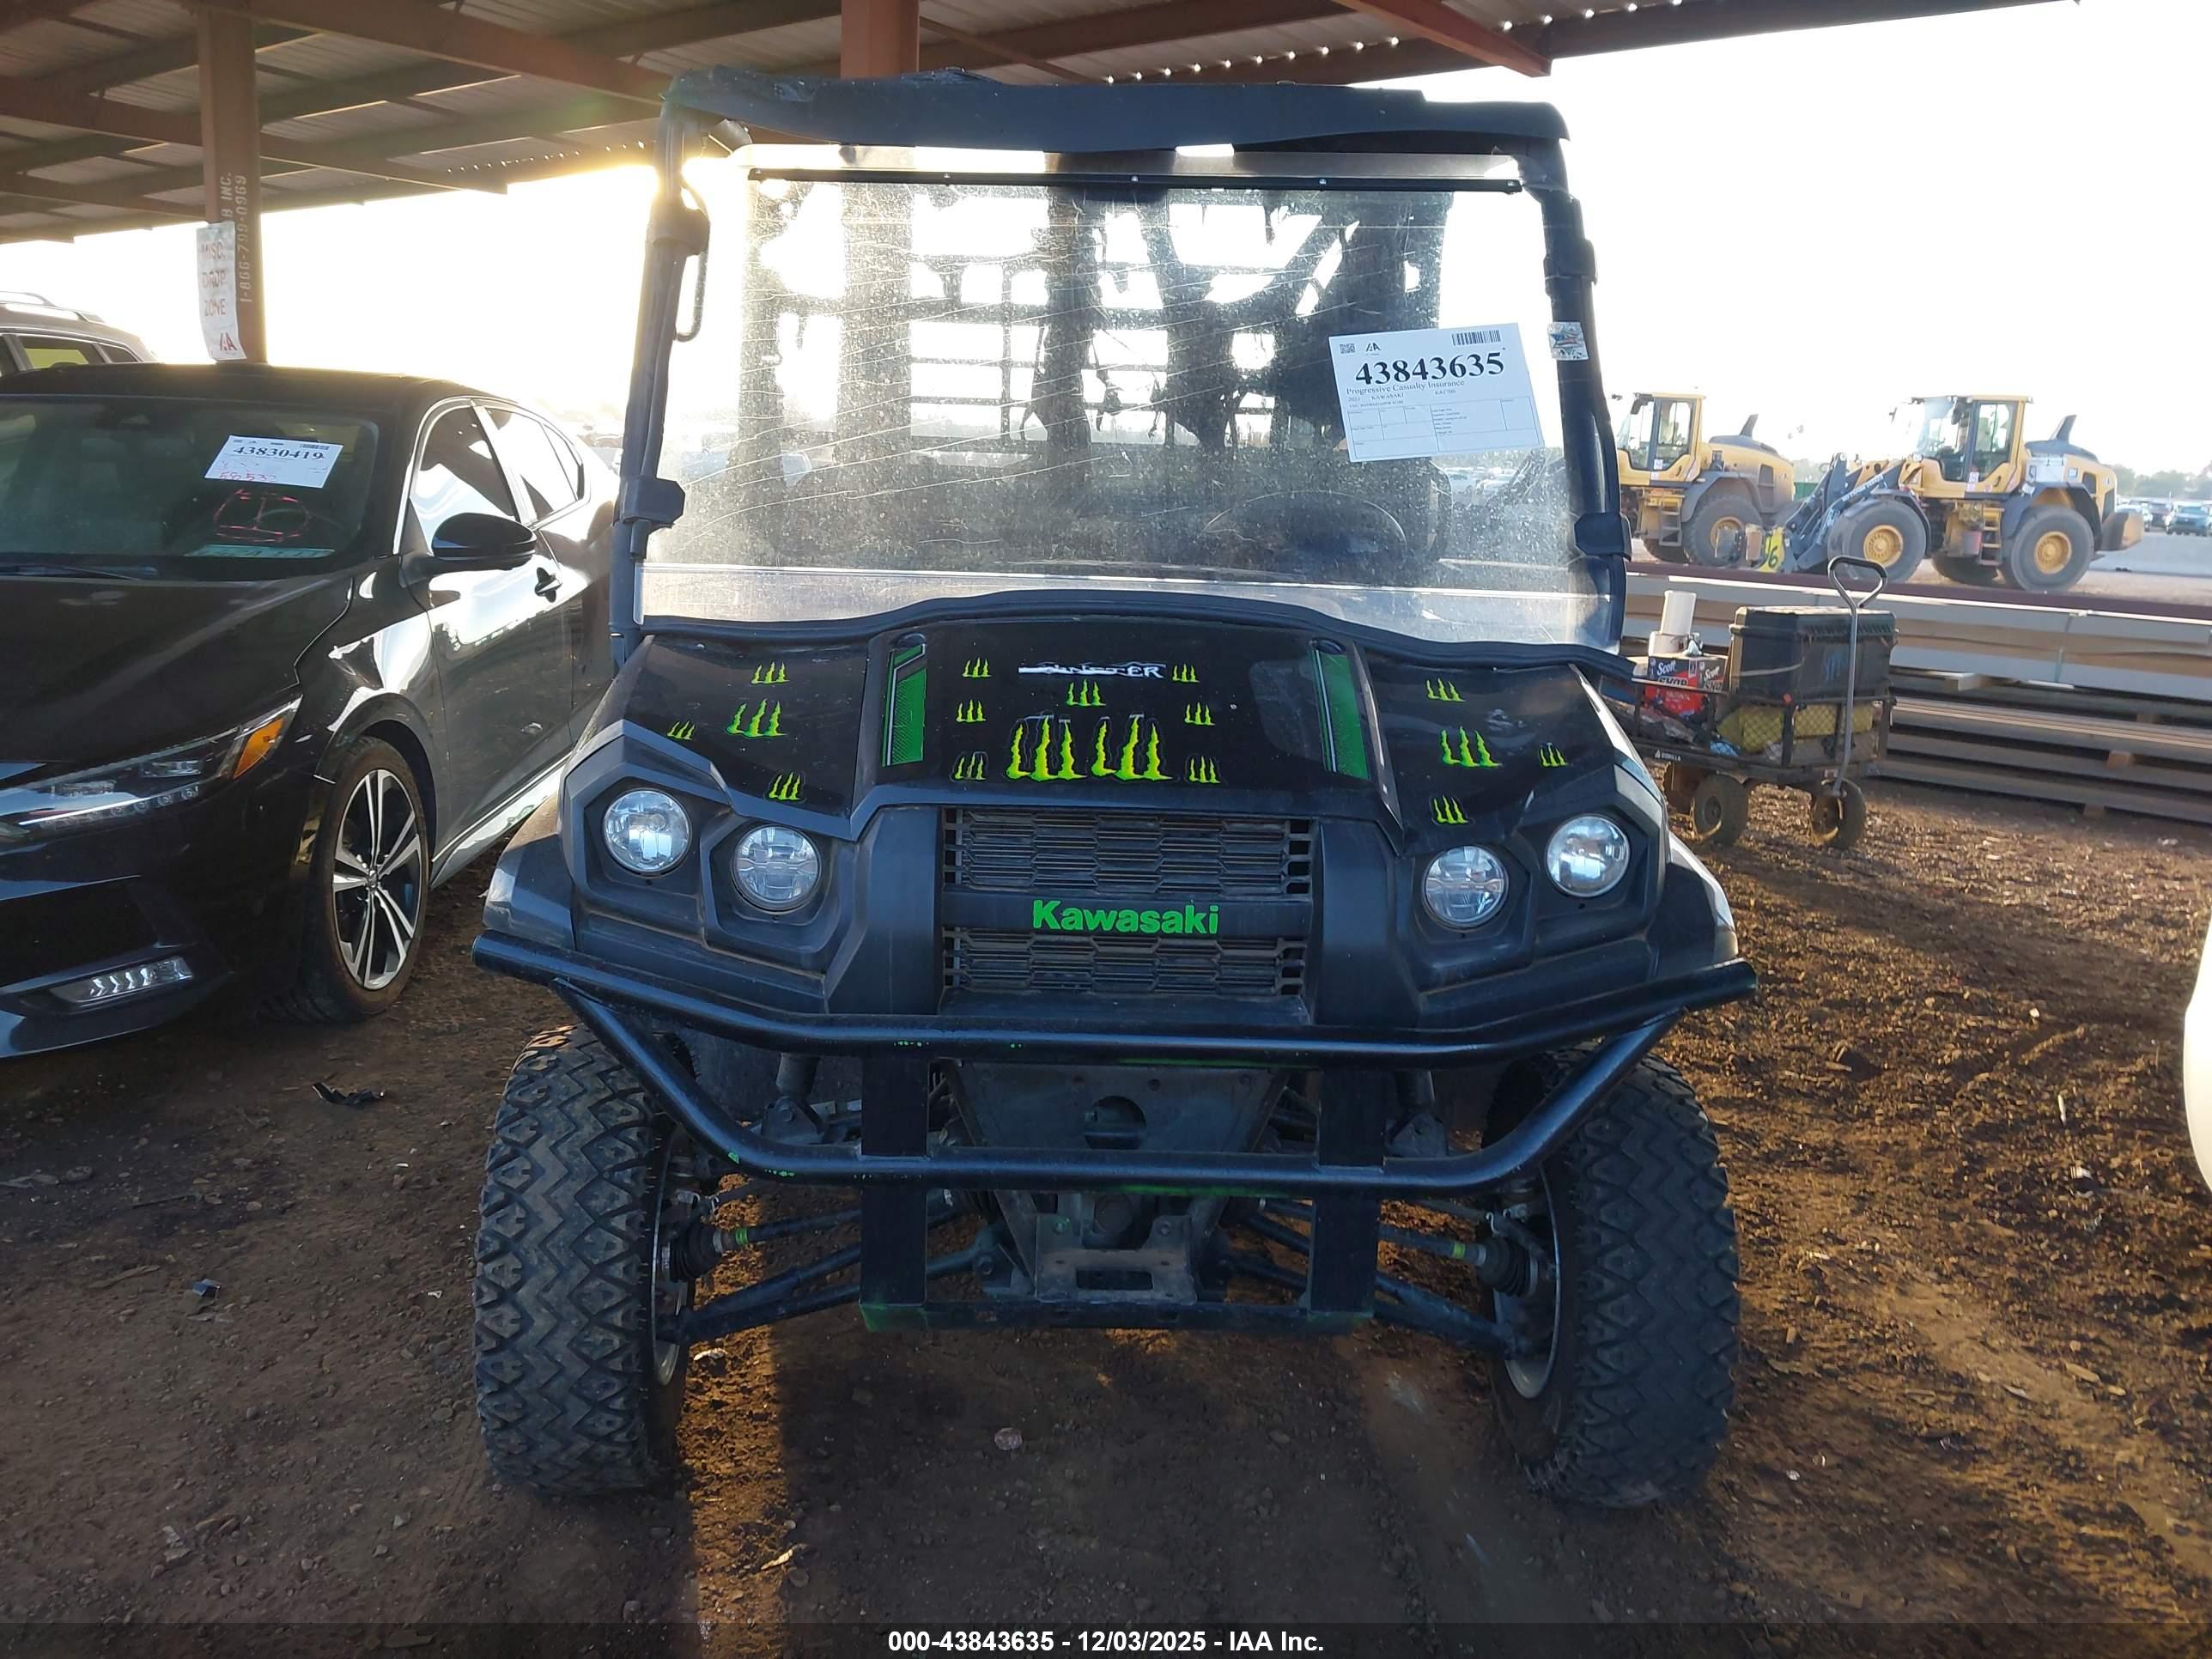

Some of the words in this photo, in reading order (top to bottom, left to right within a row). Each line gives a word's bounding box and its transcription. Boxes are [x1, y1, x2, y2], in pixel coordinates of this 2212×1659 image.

[220, 173, 232, 200] INC.
[235, 175, 252, 302] 1-866-799-0969
[202, 270, 226, 289] DROP
[204, 300, 227, 317] ZONE
[1355, 351, 1504, 386] 43843635
[1346, 386, 1391, 395] Progressive
[1393, 382, 1425, 391] Casualty
[1428, 380, 1464, 388] Insurance
[234, 446, 324, 460] 43830419
[1656, 659, 1676, 676] Scott
[1704, 665, 1720, 681] Scott
[1032, 899, 1219, 935] Kawasaki
